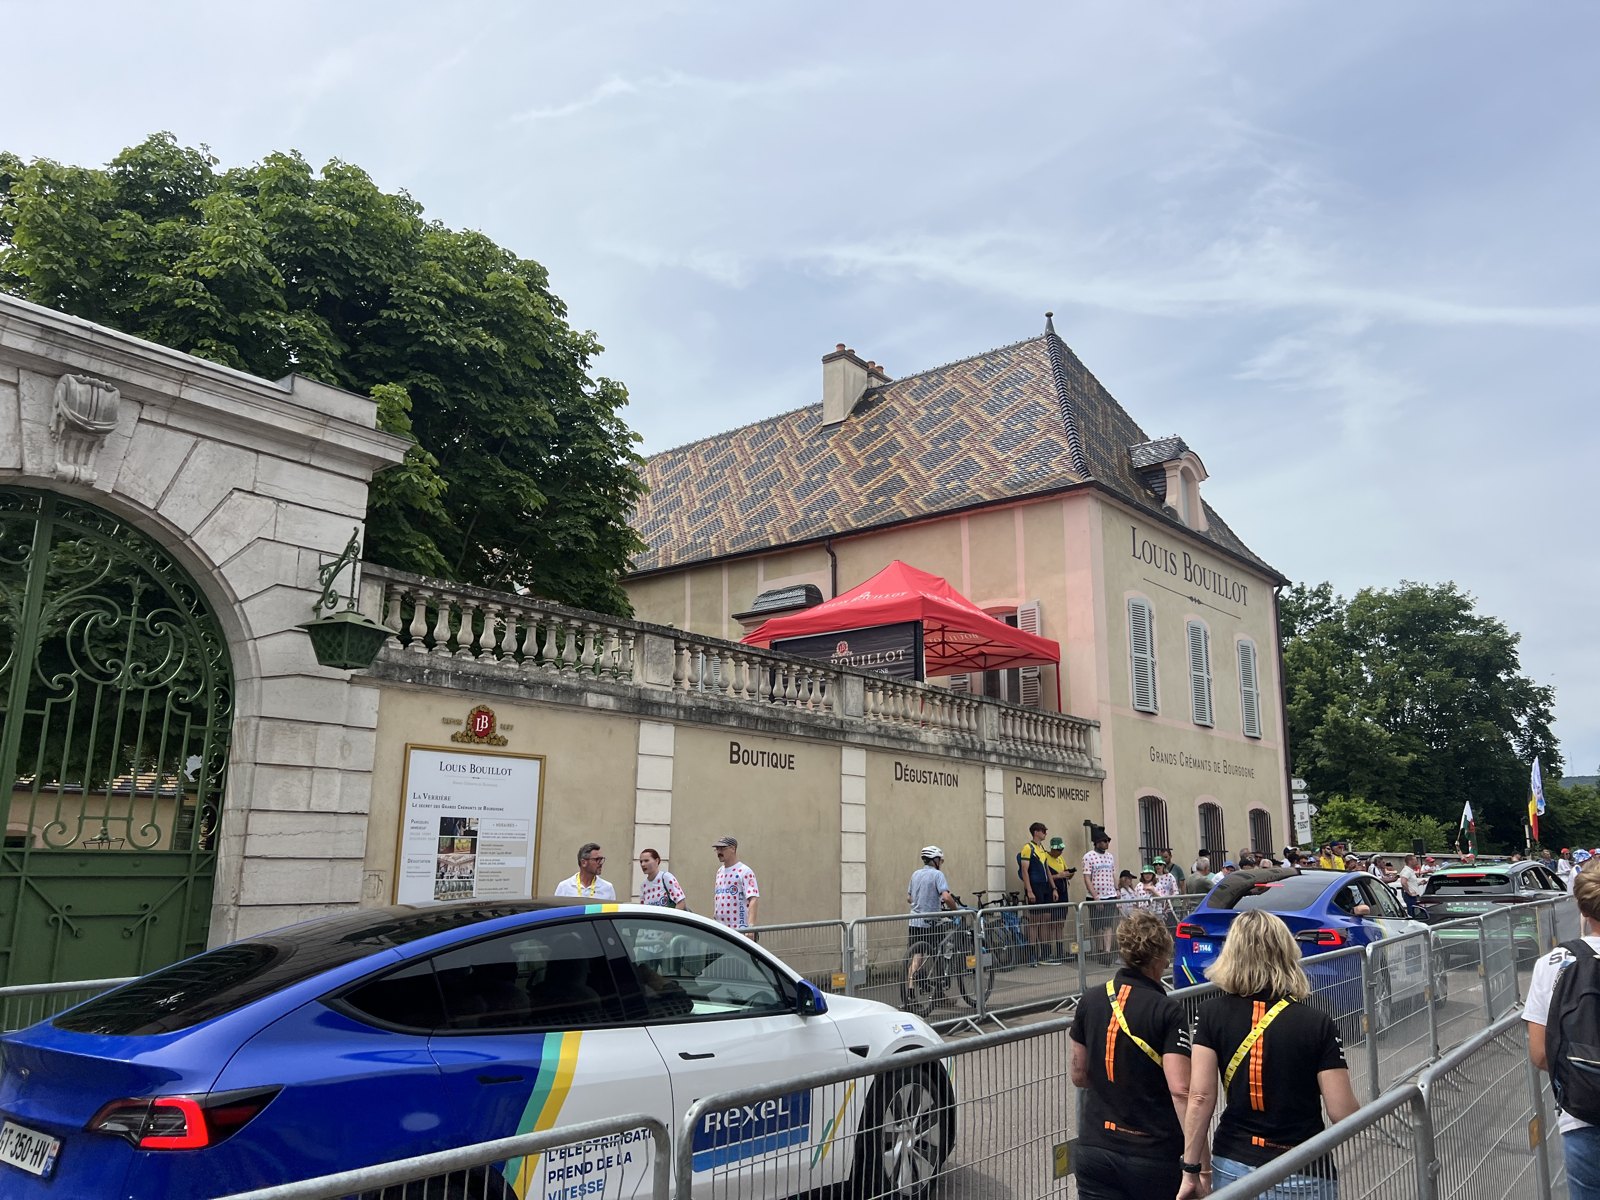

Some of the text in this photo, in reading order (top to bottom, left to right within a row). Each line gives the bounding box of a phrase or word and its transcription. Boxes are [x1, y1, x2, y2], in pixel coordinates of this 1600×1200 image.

[1131, 525, 1248, 606] LOUIS BOUILLOT
[475, 714, 489, 732] LB
[439, 761, 513, 776] LOUIS BOUILLOT
[729, 741, 796, 770] BOUTIQUE
[1149, 745, 1255, 779] GRANDS CRÉMANTS DE BOURGOGNE
[894, 761, 959, 788] DÉGUSTATION
[412, 792, 422, 800] LA
[1015, 776, 1090, 802] PARCOURS IMMERSIF
[548, 1151, 633, 1184] PREND DE LA
[547, 1179, 605, 1200] VITESSE
